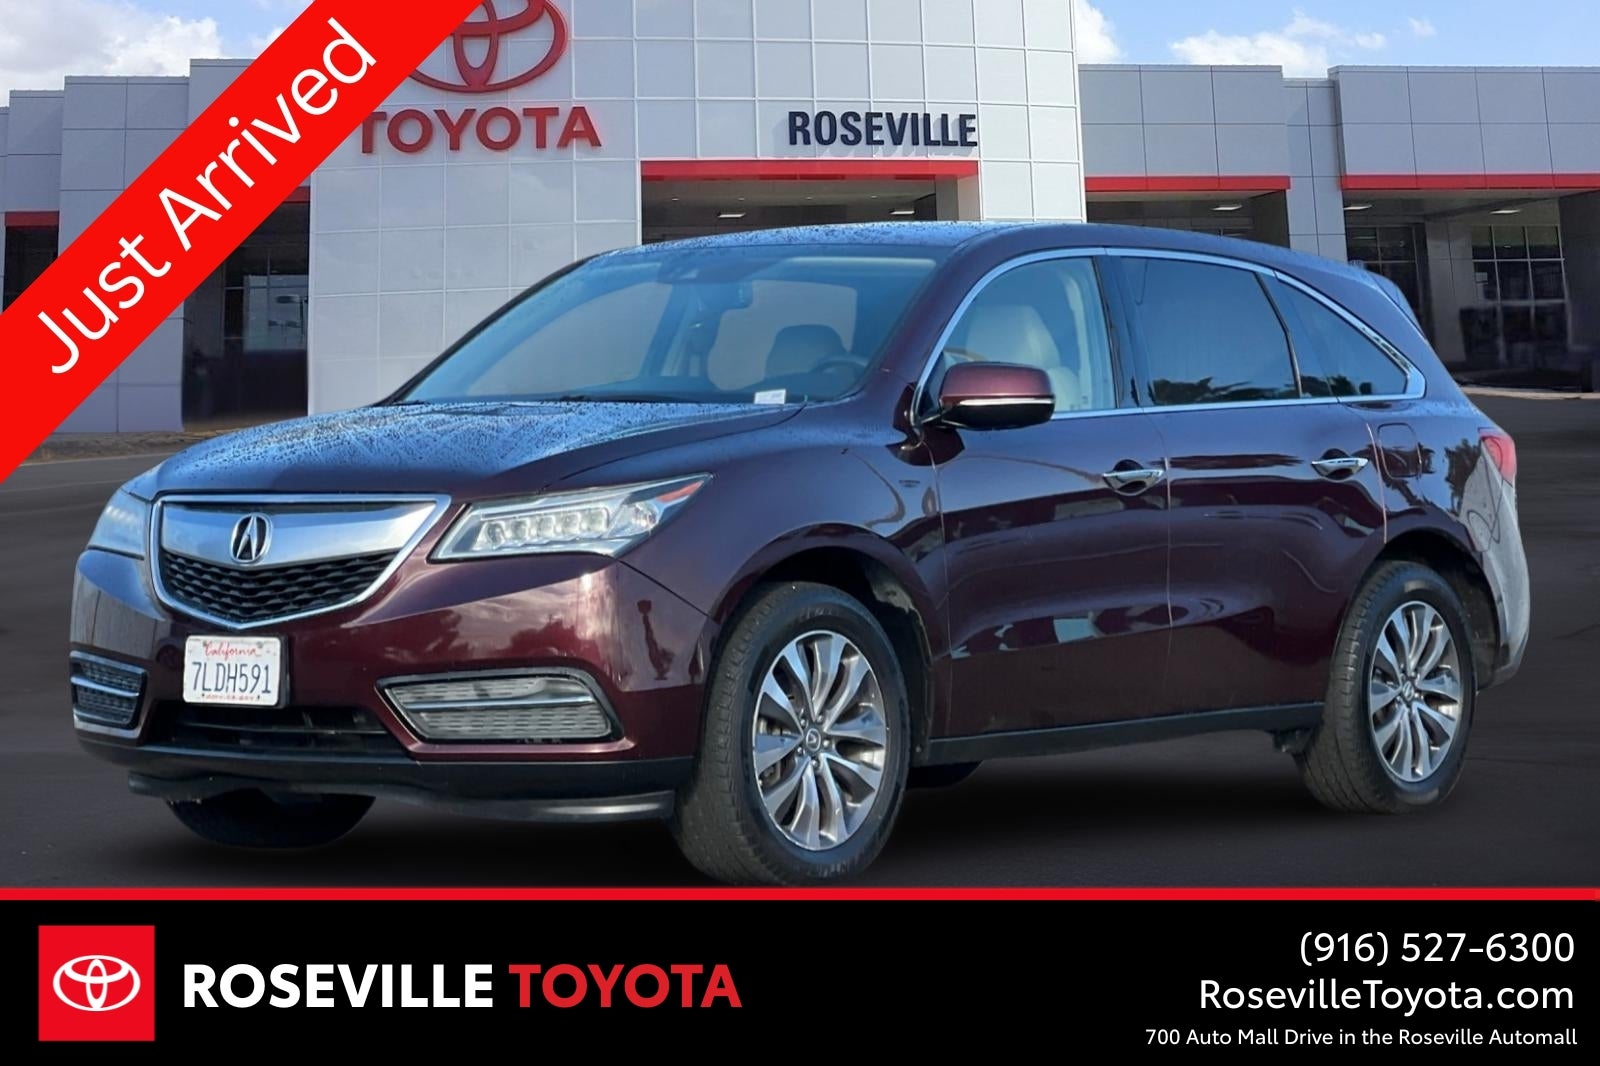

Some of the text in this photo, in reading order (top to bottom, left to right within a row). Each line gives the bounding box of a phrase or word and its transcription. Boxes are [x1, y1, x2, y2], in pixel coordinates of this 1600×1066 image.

[361, 106, 601, 153] TOYOTA
[788, 111, 978, 147] ROSEVILLE
[204, 640, 260, 661] California
[191, 661, 271, 694] 7LDH591
